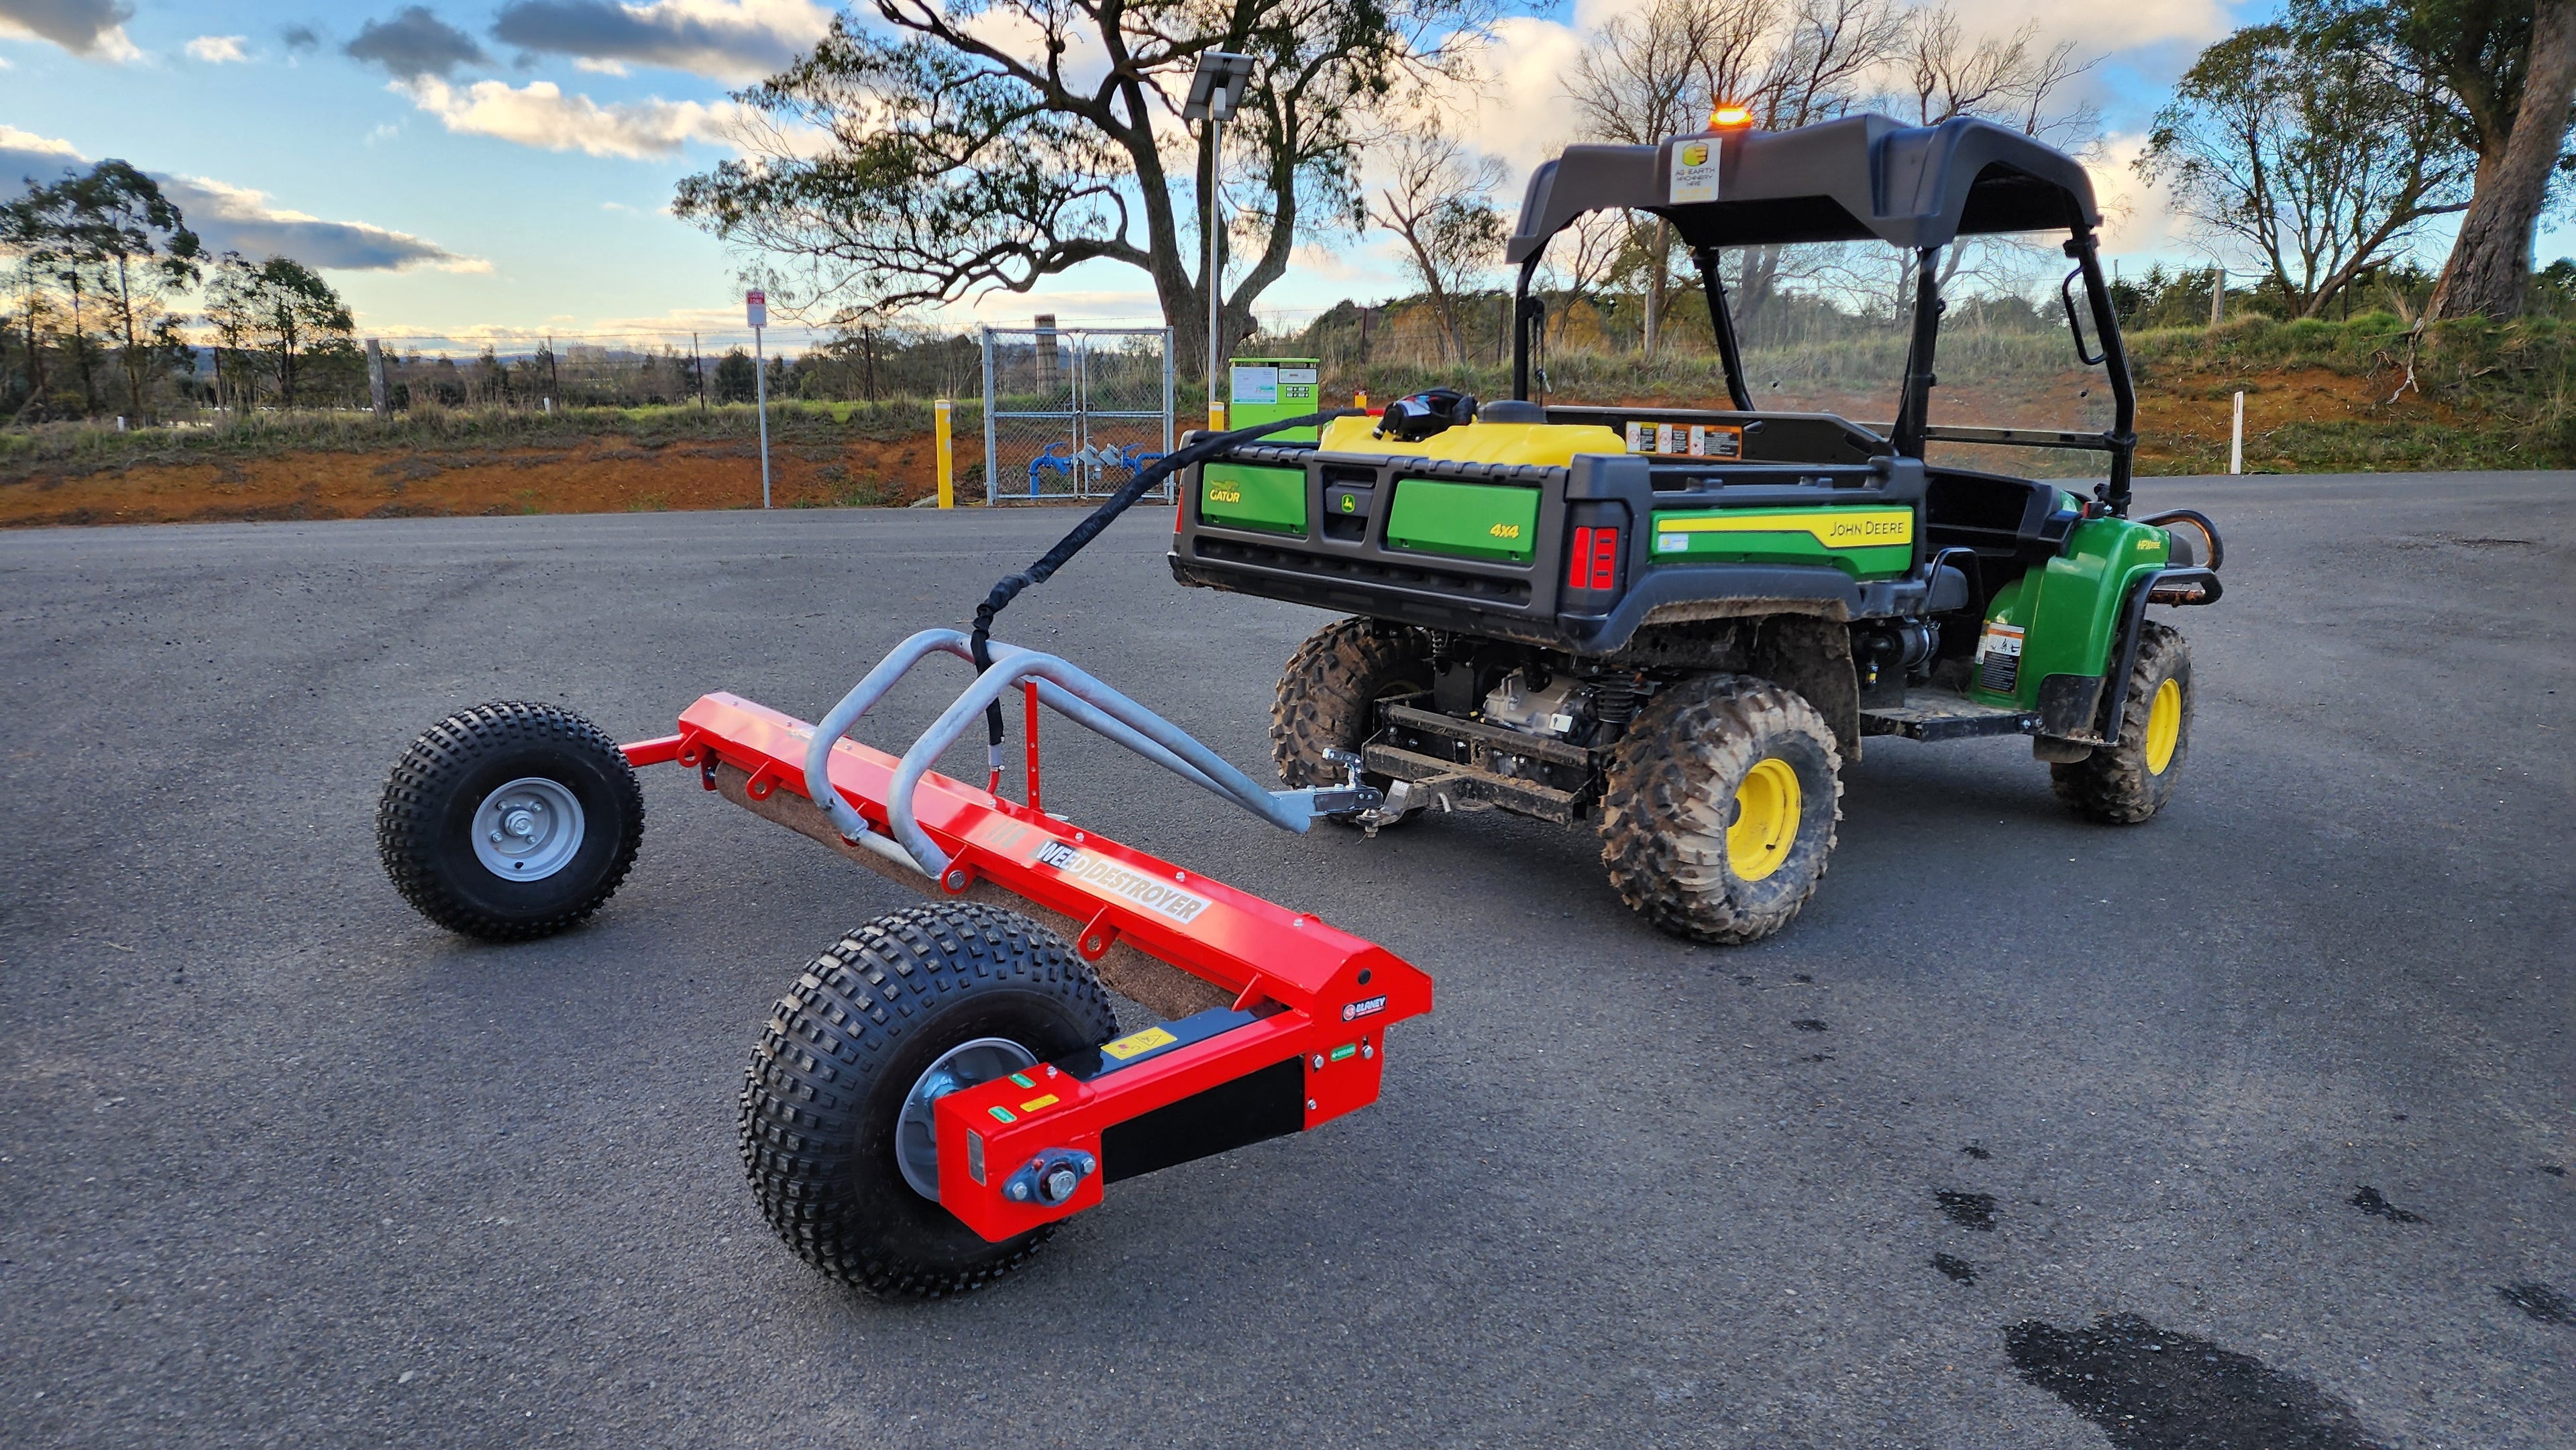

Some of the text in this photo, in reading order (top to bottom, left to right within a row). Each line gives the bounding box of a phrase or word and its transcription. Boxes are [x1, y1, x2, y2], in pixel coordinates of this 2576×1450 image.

[1210, 489, 1240, 503] GATOR
[1830, 521, 1904, 536] JOHN DEERE
[1036, 840, 1202, 919] WEED DESTROYER
[1356, 997, 1386, 1013] BLANEY
